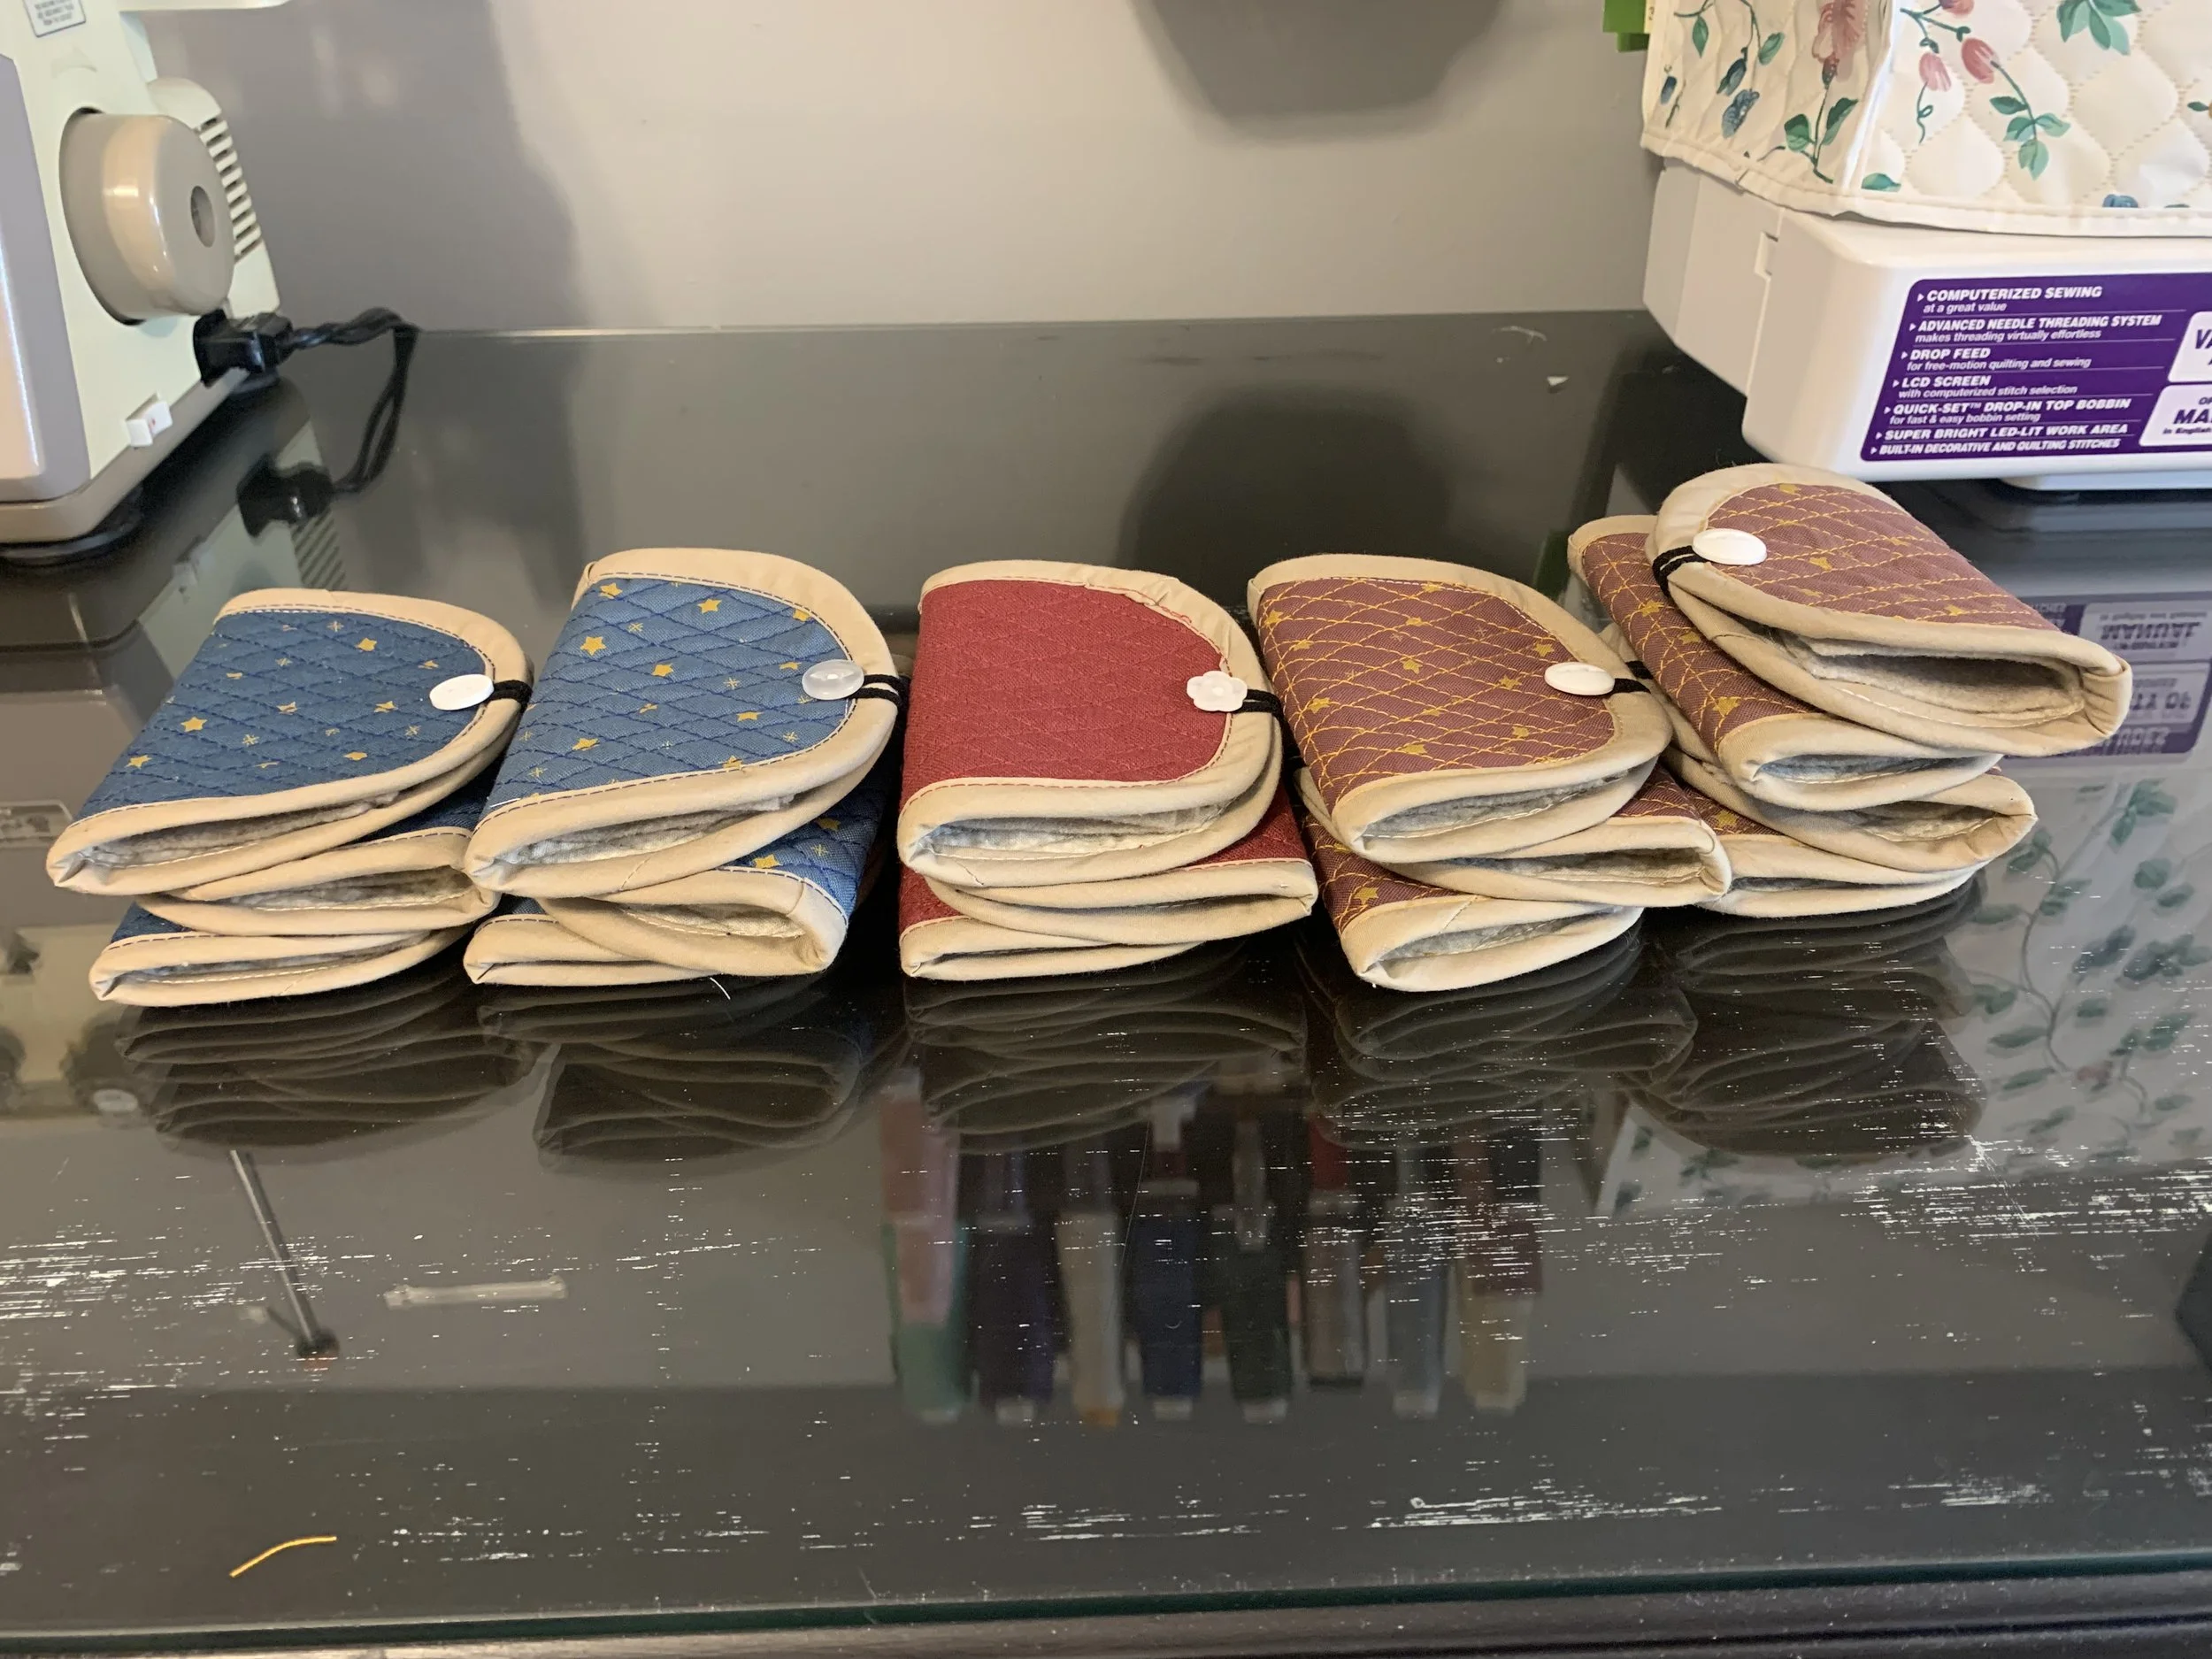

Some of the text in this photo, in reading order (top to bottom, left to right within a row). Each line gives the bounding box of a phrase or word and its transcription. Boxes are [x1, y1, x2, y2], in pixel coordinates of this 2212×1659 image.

[1926, 286, 2102, 302] COMPUTERIZED SEWING
[1924, 302, 2008, 314] at a great value
[1918, 314, 2162, 332] ADVANCED NEEDLE THREADING SYSTEM
[1915, 329, 2101, 343] makes threading virtually effortless
[1910, 348, 1991, 360] DROP FEED
[1907, 357, 2092, 371] for free-motion quilting and sewing
[1902, 375, 1991, 388] LCD SCREEN
[1899, 385, 2078, 398] with computerized stitch selection
[1984, 401, 2042, 412] DROP-IN
[2046, 400, 2074, 411] TOP
[2076, 398, 2131, 410] BOBBIN
[1890, 412, 2041, 425] for fast & easy bobbin setting
[1885, 424, 2128, 441] SUPER BRIGHT LED-LIT WORK AREA
[1879, 438, 2121, 455] BUILT-IN DECORATIVE AND QUILTING STITCHES
